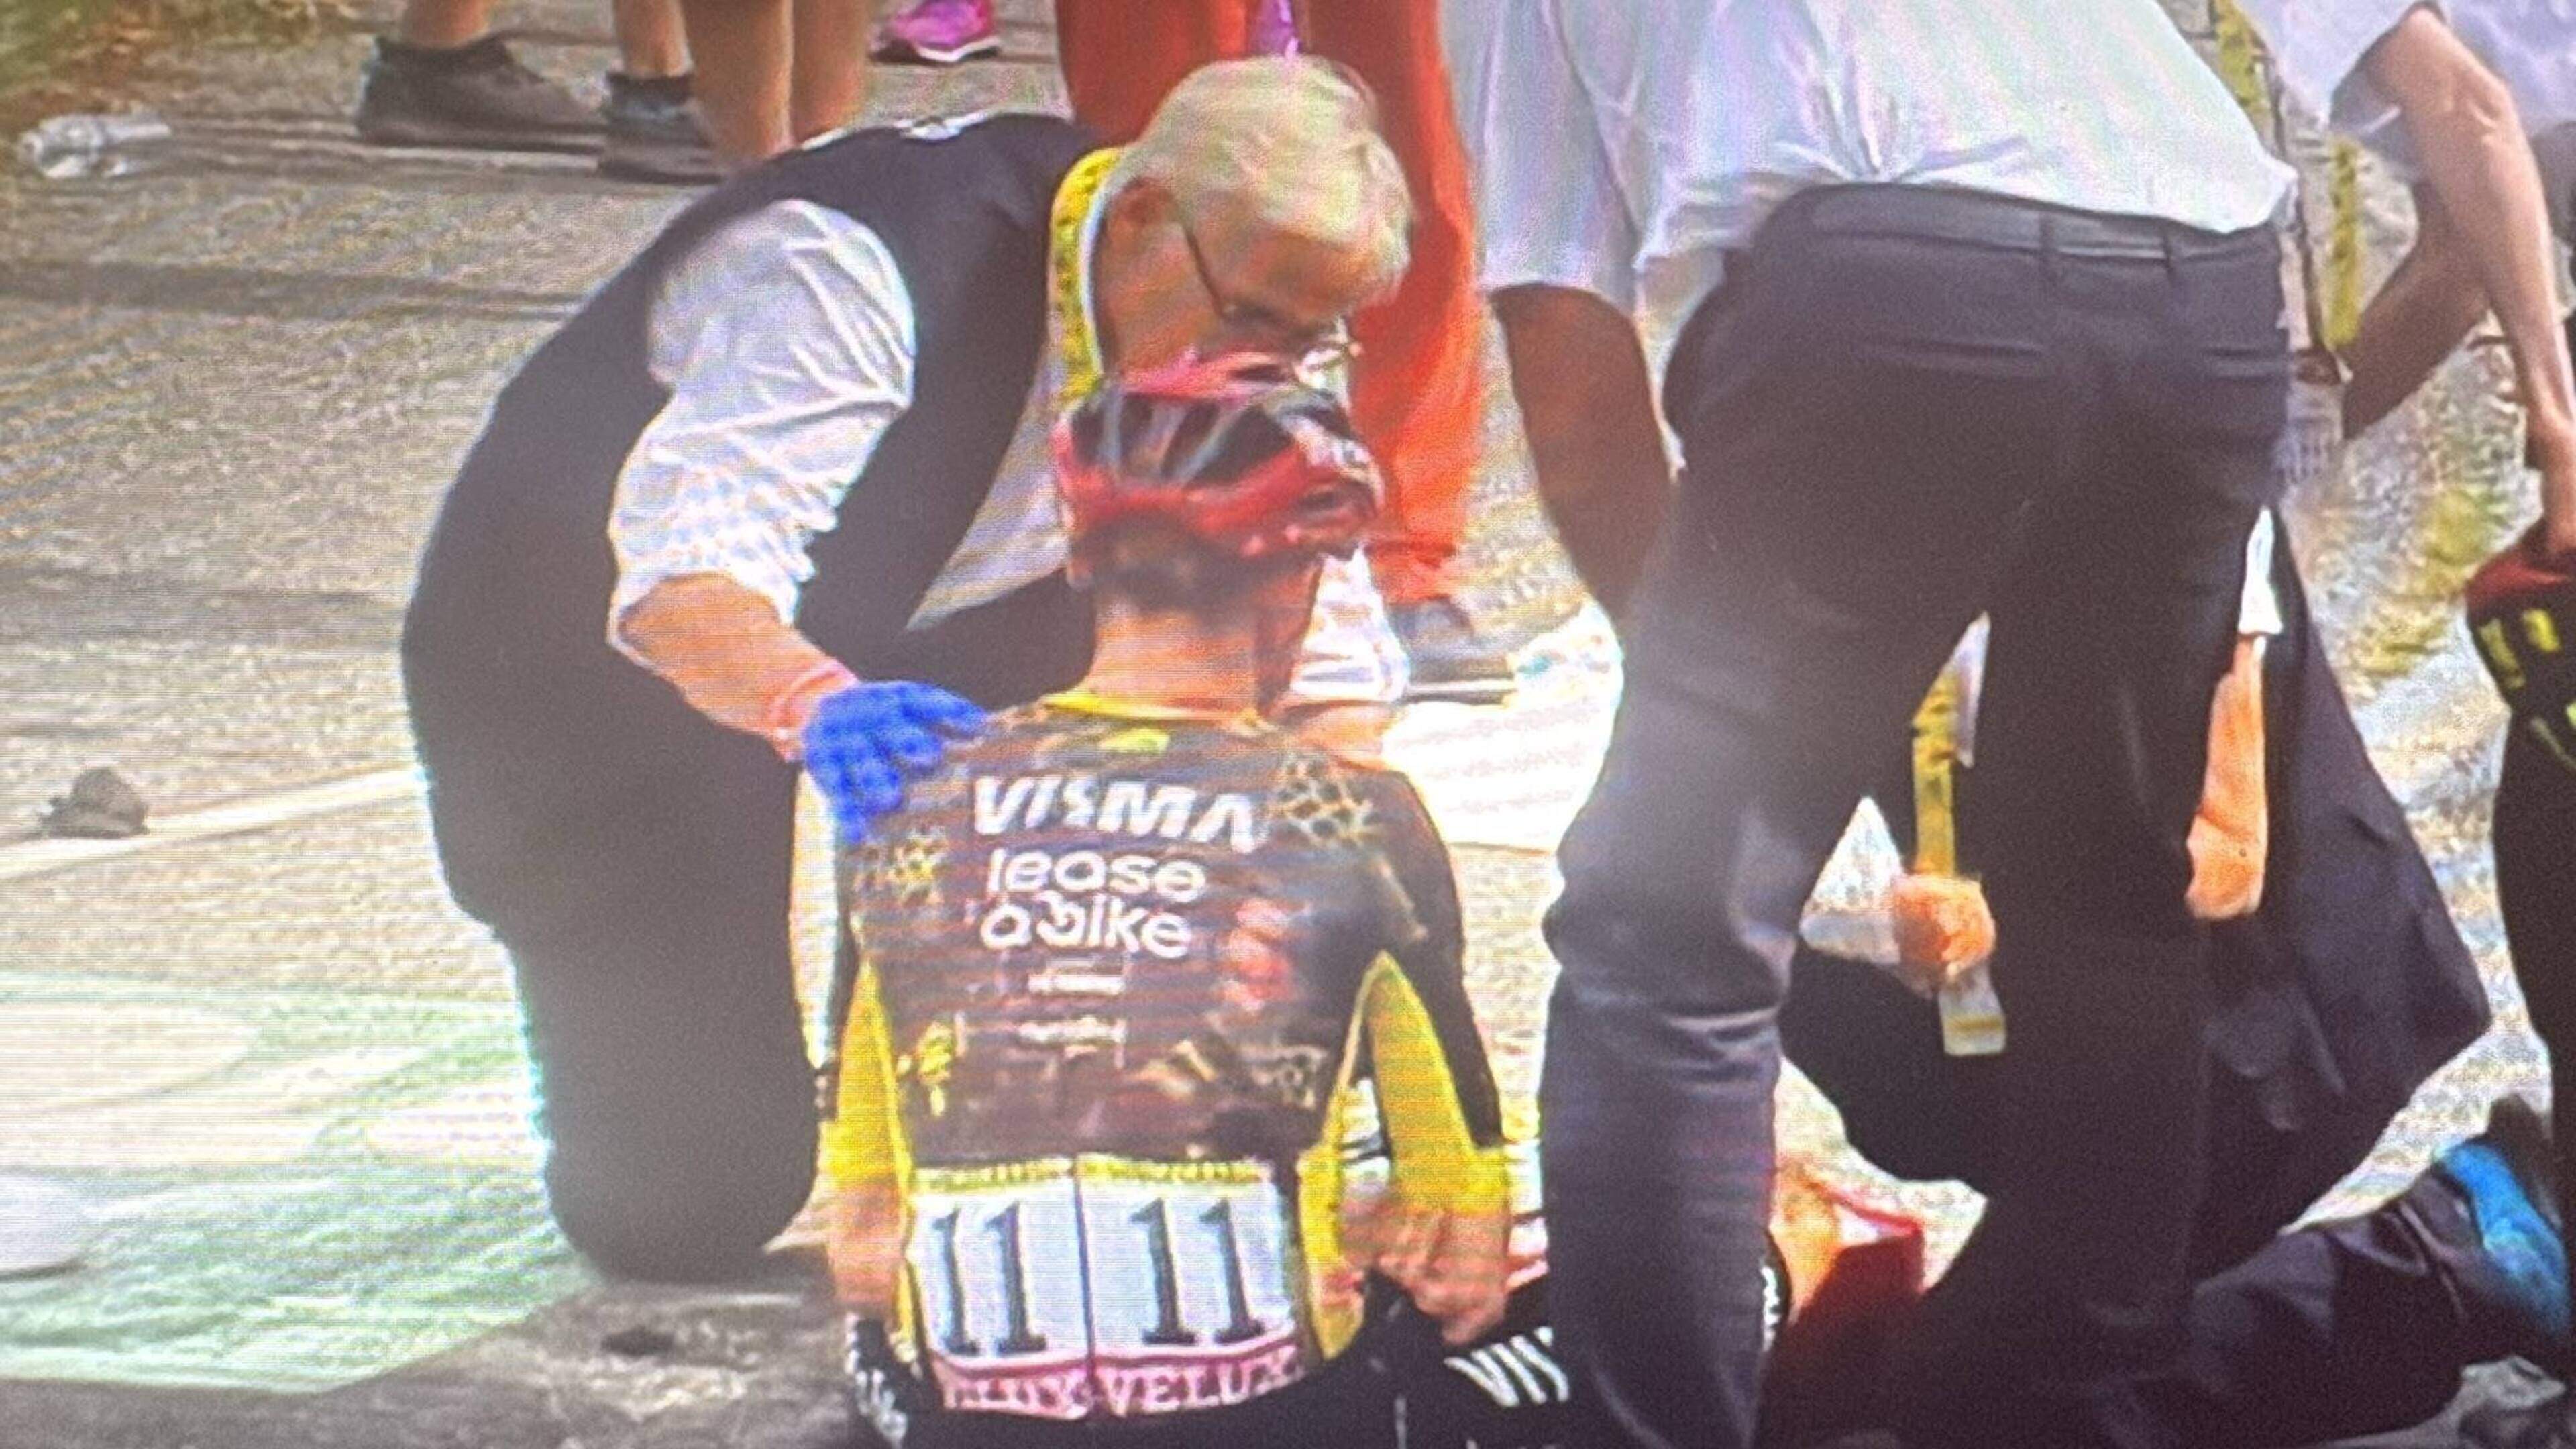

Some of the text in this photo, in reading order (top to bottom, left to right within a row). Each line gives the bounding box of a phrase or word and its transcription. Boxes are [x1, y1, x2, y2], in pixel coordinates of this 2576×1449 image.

[973, 773, 1257, 853] VISMA
[986, 847, 1207, 903] lease
[931, 1199, 1047, 1356] 11
[1130, 1197, 1265, 1345] 11
[942, 1368, 1088, 1418] ELUX
[1097, 1344, 1300, 1417] VELUX
[1443, 1326, 1570, 1407] VIS
